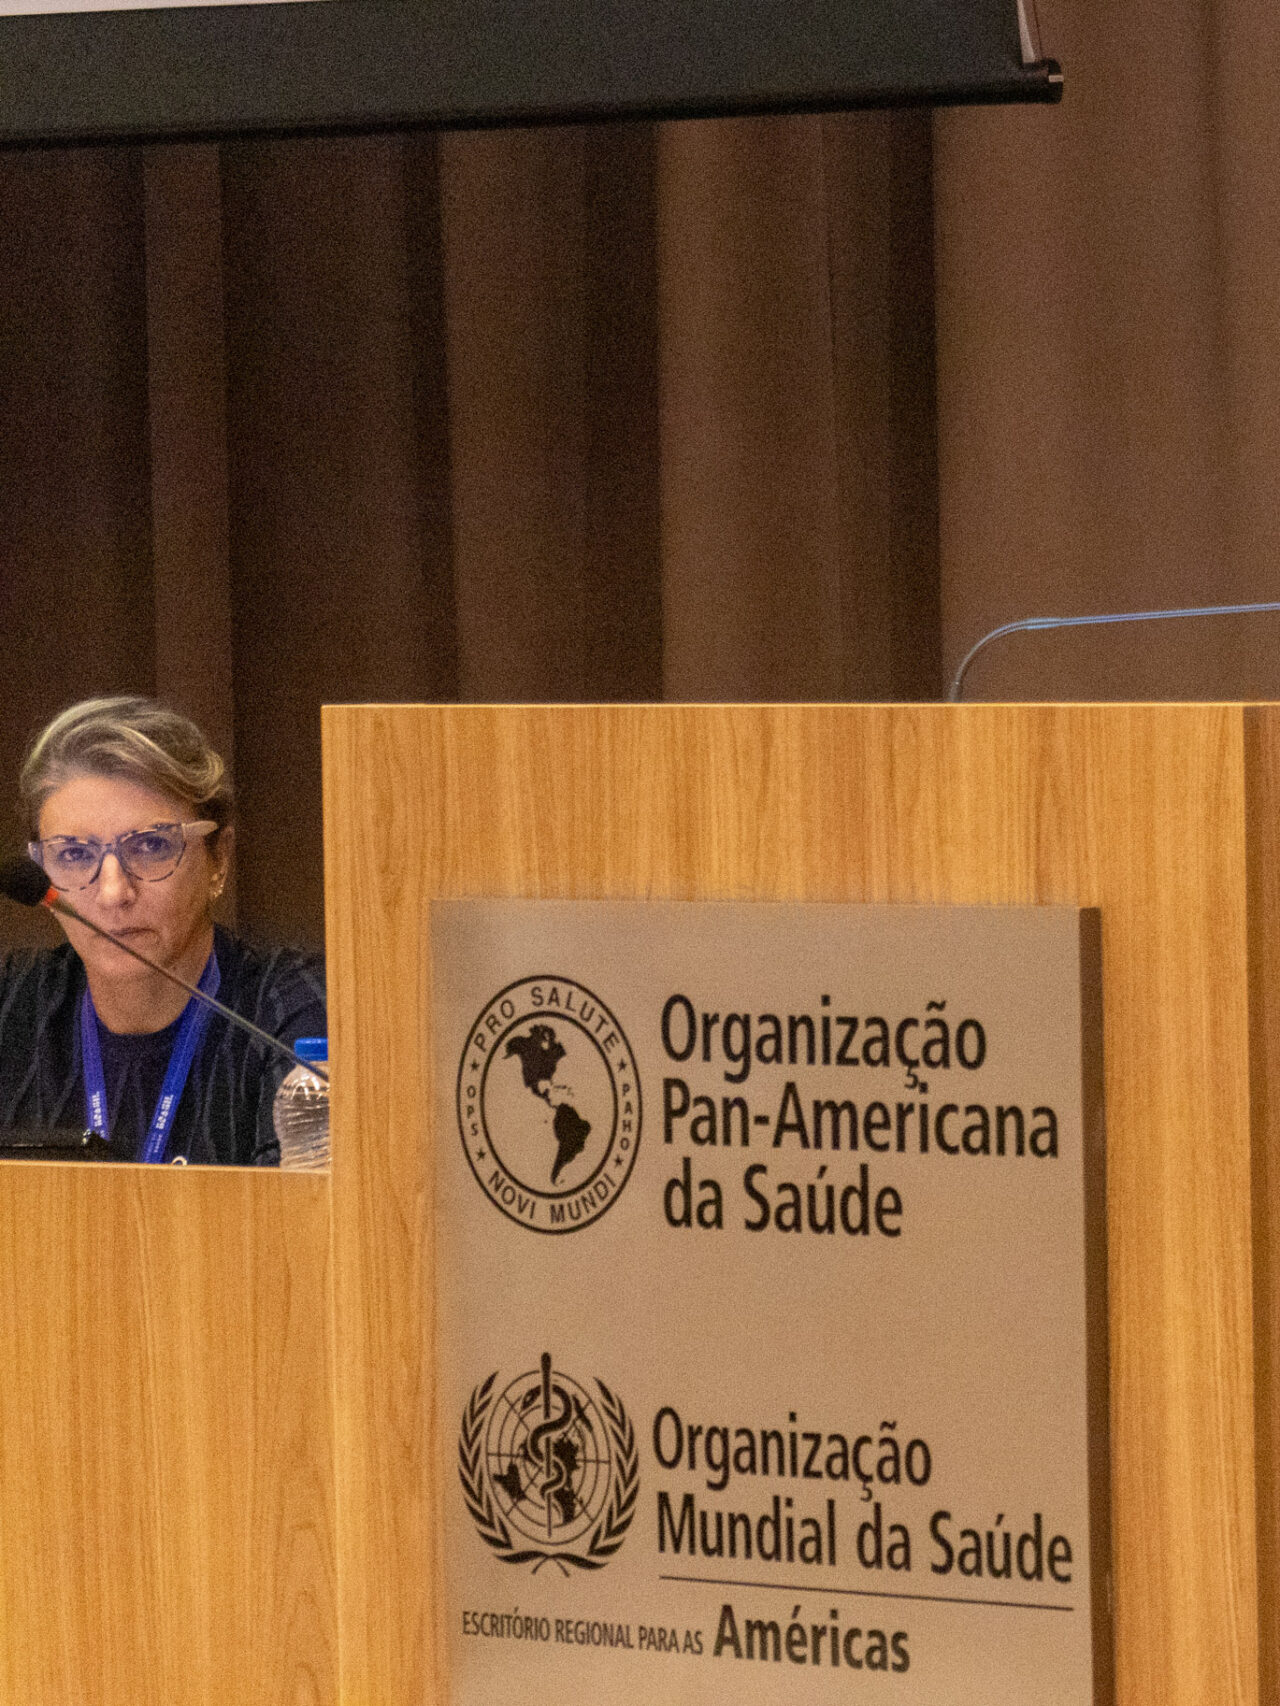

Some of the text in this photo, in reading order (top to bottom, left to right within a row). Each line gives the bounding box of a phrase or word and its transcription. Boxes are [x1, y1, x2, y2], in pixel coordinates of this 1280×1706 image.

[473, 986, 621, 1055] PRO SALUTE
[660, 994, 987, 1089] Organização
[466, 1085, 479, 1137] OPS
[622, 1084, 633, 1152] PAHO
[662, 1078, 1059, 1158] Pan-Americana
[488, 1170, 617, 1224] NOVI MUNDI
[663, 1157, 903, 1238] da Saúde
[653, 1406, 931, 1501] Organização
[657, 1491, 1072, 1583] Mundial da Saúde
[462, 1604, 910, 1673] ESCRITÓRIO REGIONAL PARA AS Américas
